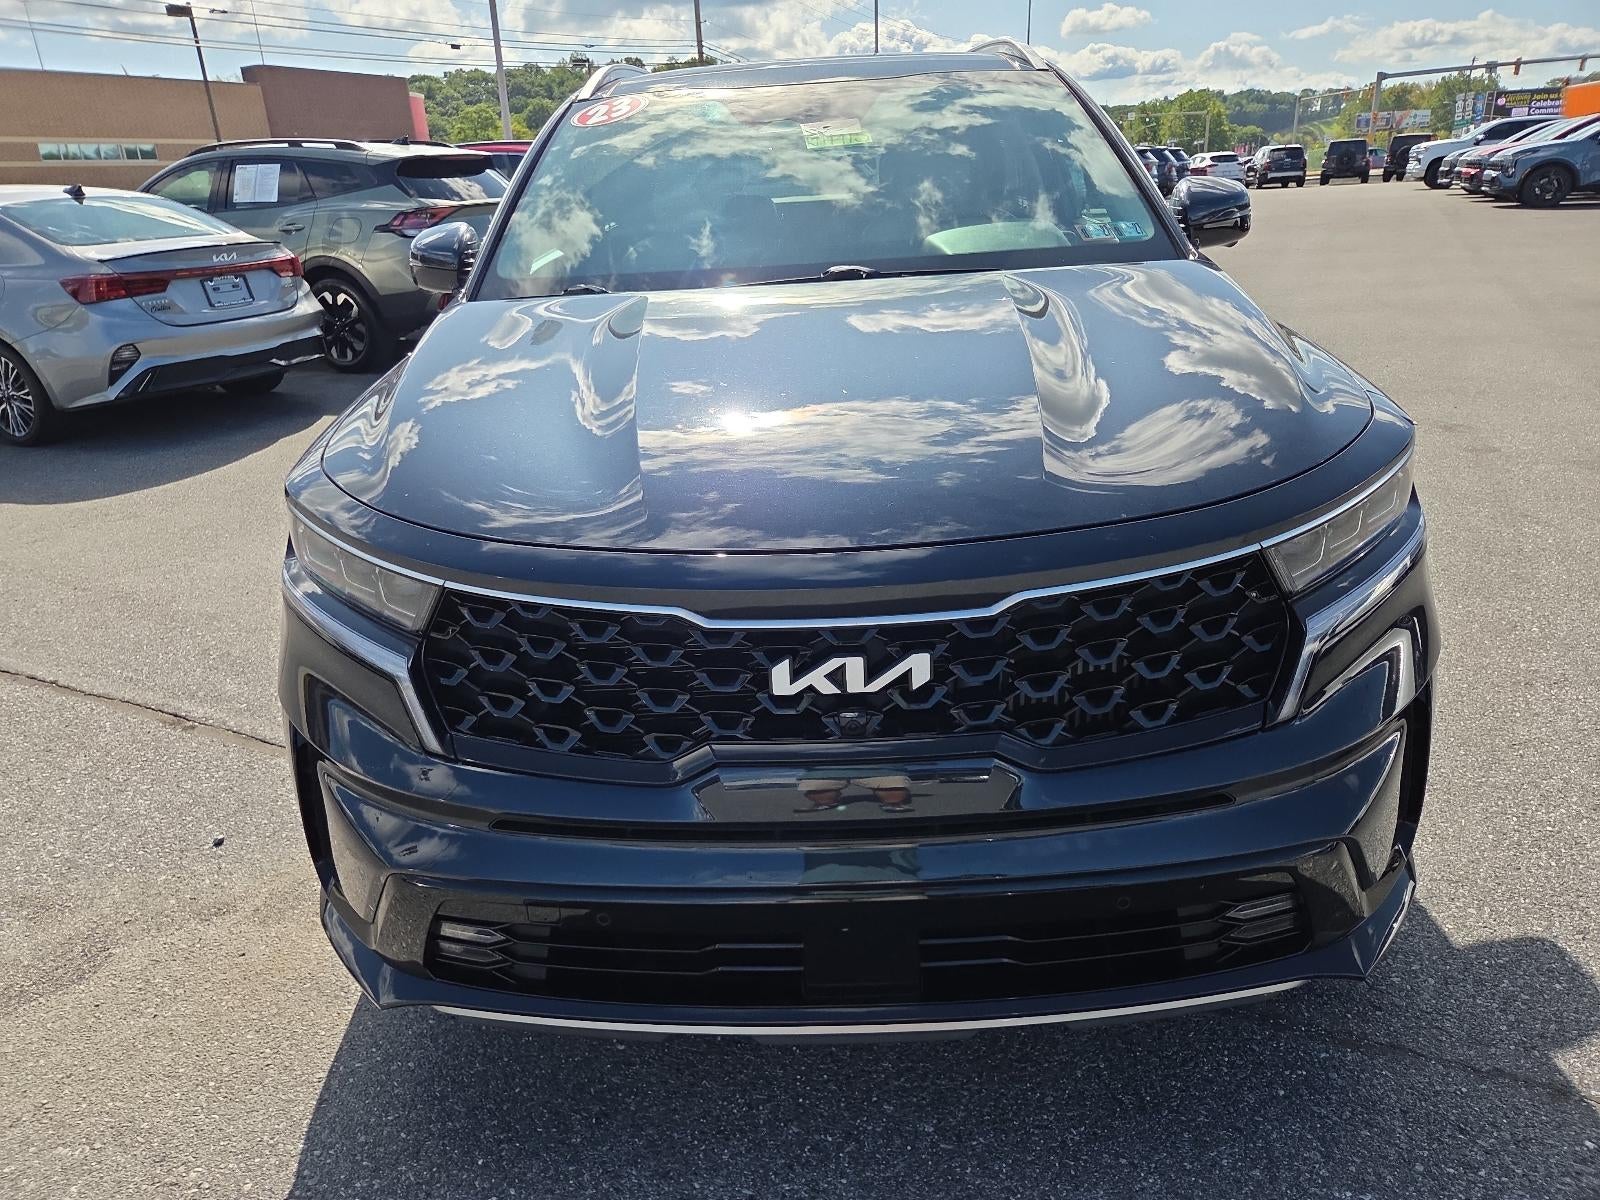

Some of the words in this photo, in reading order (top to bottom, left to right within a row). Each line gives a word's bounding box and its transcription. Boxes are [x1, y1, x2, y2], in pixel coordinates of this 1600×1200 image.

[586, 96, 633, 124] 23
[212, 252, 237, 262] KIA
[771, 652, 932, 696] KIA
